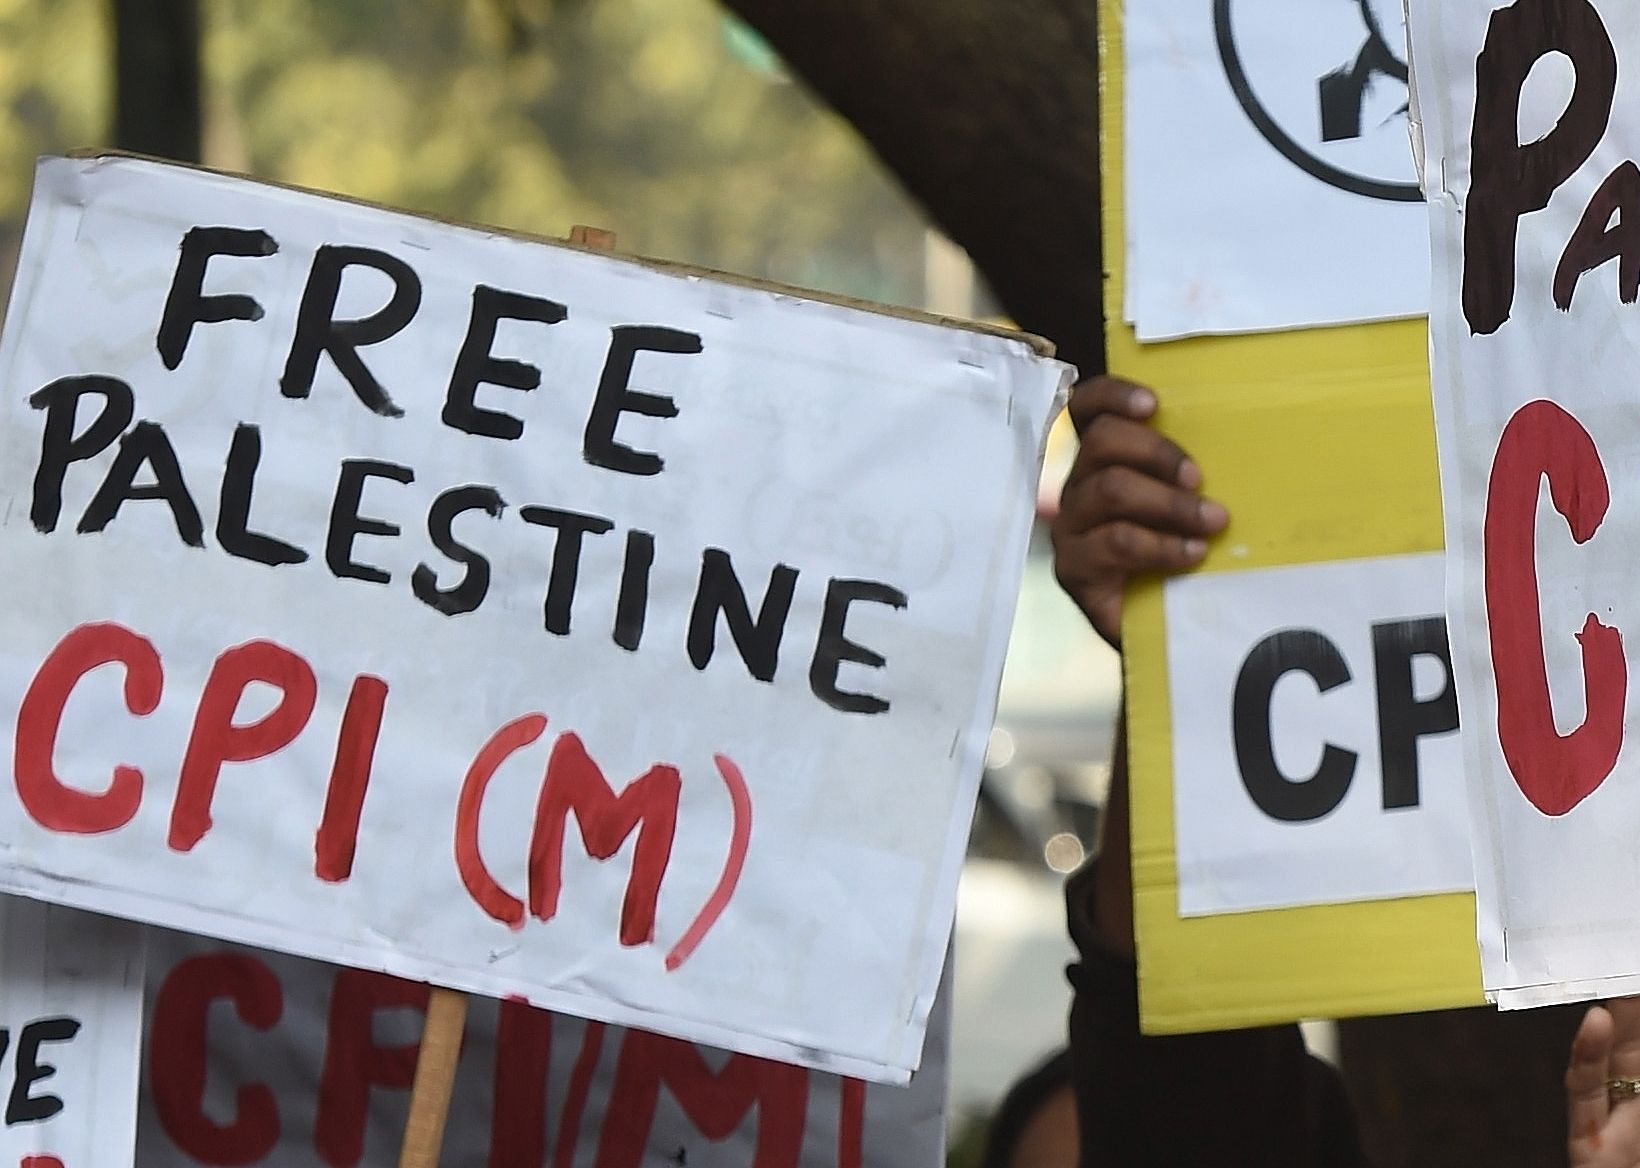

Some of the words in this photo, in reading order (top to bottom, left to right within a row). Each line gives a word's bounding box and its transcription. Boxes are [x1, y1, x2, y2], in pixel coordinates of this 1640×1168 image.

[157, 227, 703, 476] FREE
[29, 374, 908, 714] PALESTINE
[14, 621, 389, 883] CPI
[455, 711, 753, 971] (M)
